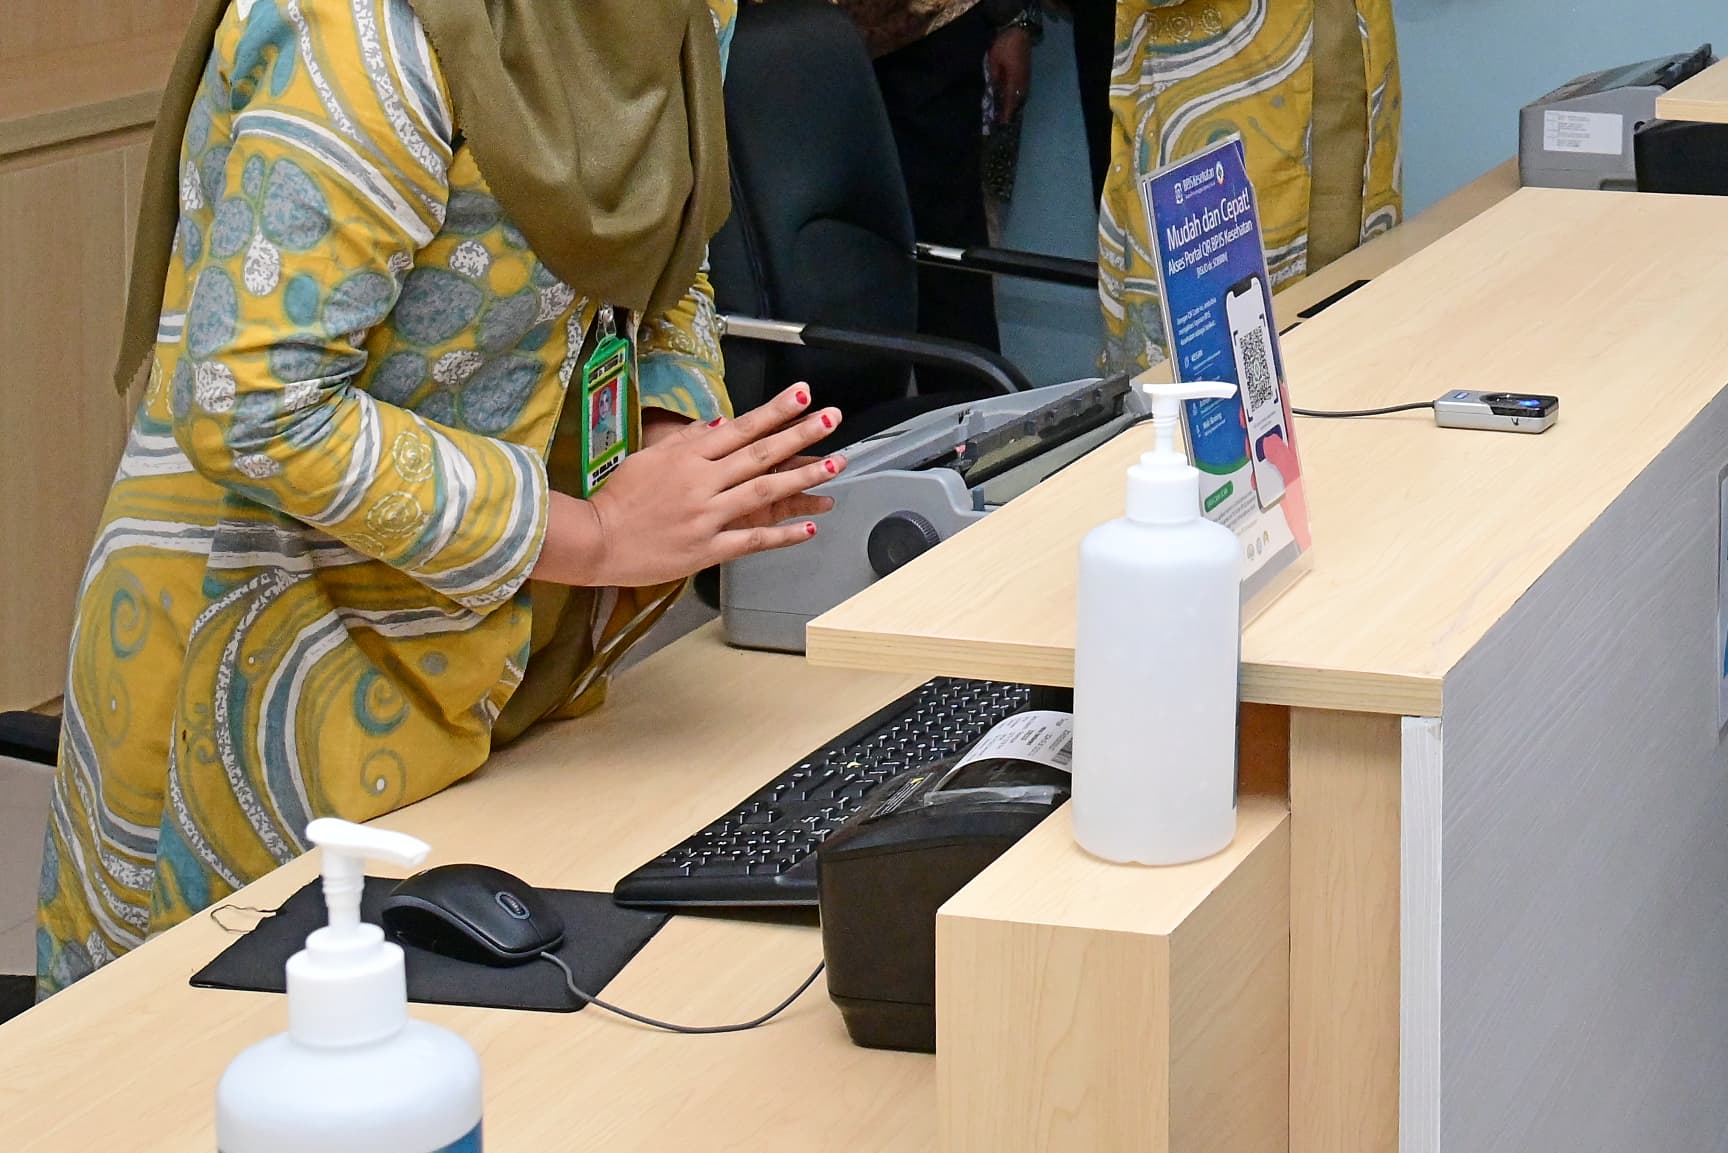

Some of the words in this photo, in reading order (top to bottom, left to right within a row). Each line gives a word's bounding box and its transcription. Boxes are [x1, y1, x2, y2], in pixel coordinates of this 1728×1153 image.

[1166, 213, 1202, 251] Mudah
[1202, 207, 1222, 233] dan
[1220, 187, 1251, 223] Cepat!
[1168, 259, 1186, 276] Akses
[1184, 243, 1203, 266] Portal
[1201, 240, 1212, 257] QR
[1210, 231, 1225, 252] BPJS
[1224, 219, 1253, 246] Kesehatan
